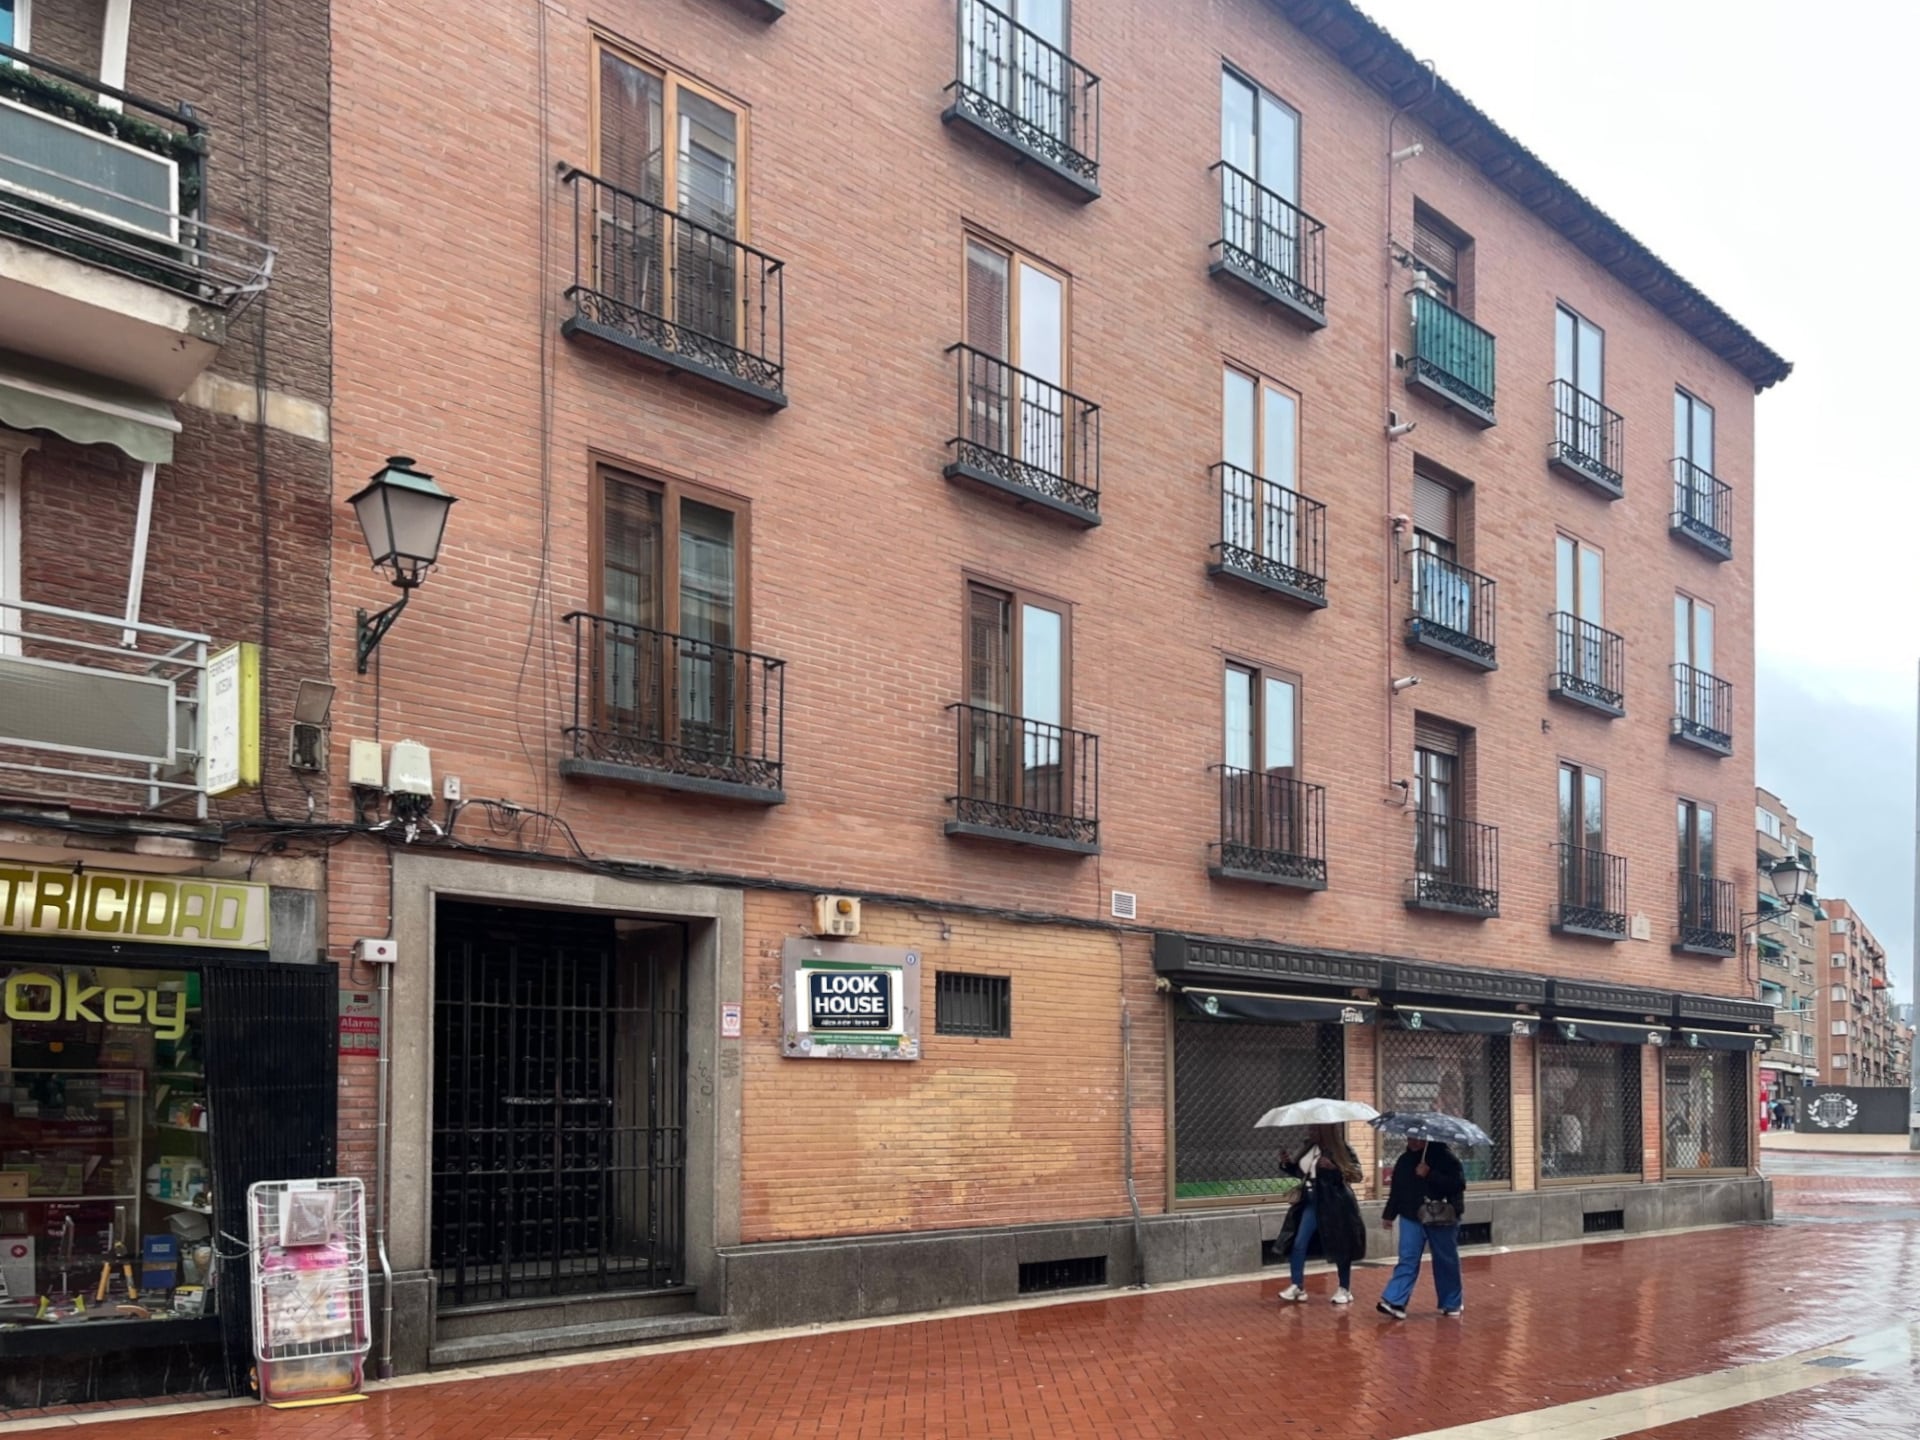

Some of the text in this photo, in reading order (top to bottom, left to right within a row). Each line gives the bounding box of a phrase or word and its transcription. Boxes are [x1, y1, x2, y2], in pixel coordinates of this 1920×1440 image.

[0, 869, 248, 940] TRICIDAD
[4, 972, 186, 1040] Okey
[814, 996, 886, 1014] HOUSE
[820, 975, 880, 994] LOOK
